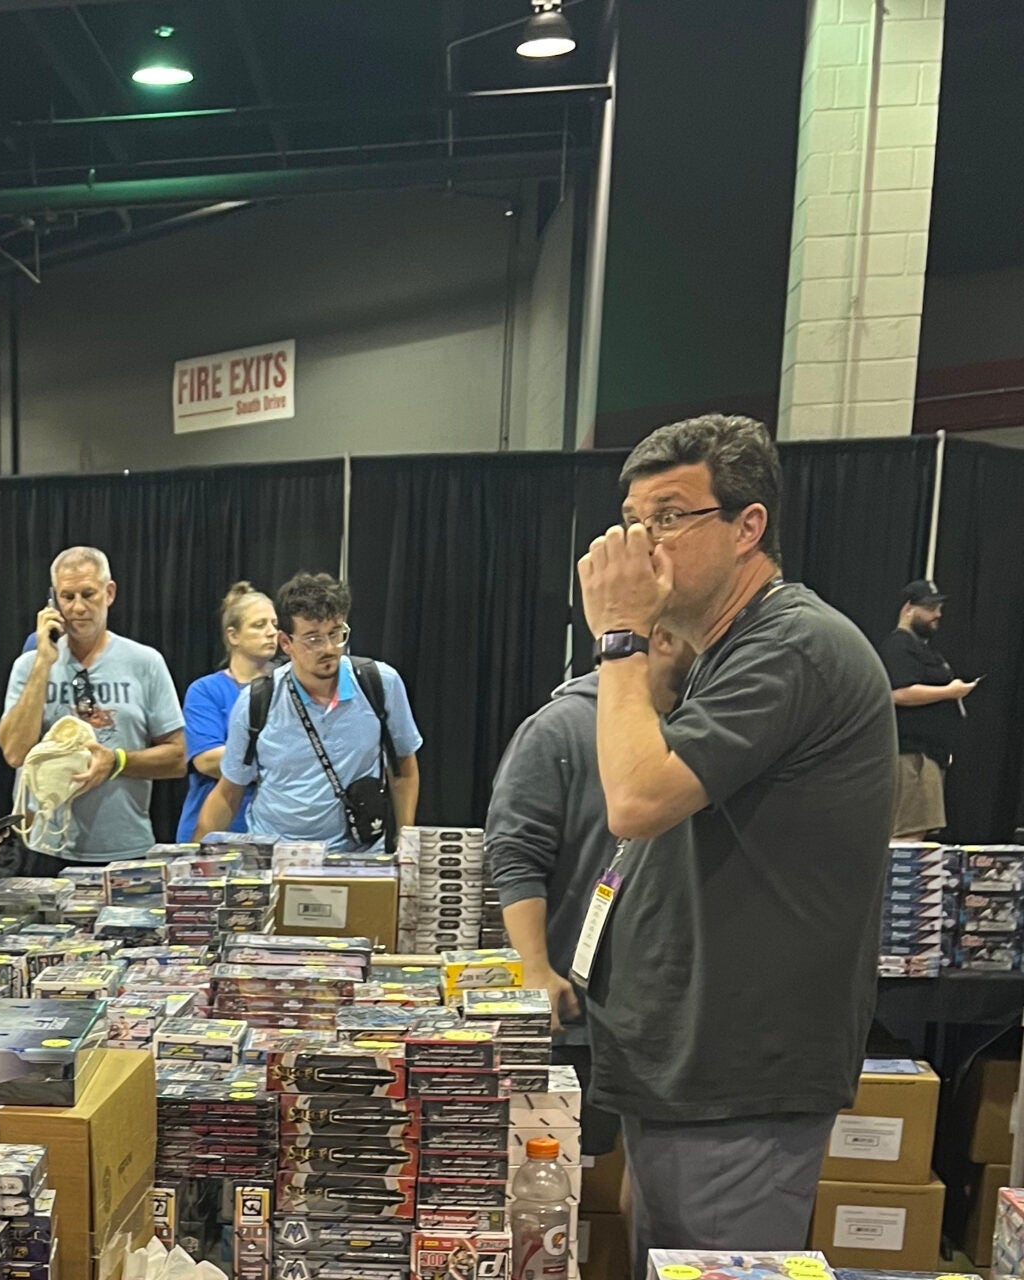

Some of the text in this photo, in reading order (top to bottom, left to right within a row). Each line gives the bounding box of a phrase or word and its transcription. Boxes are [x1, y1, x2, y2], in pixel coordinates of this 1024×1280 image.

[178, 350, 287, 404] FIRE EXITS
[236, 394, 286, 415] South Drive
[47, 682, 130, 705] DEOIT
